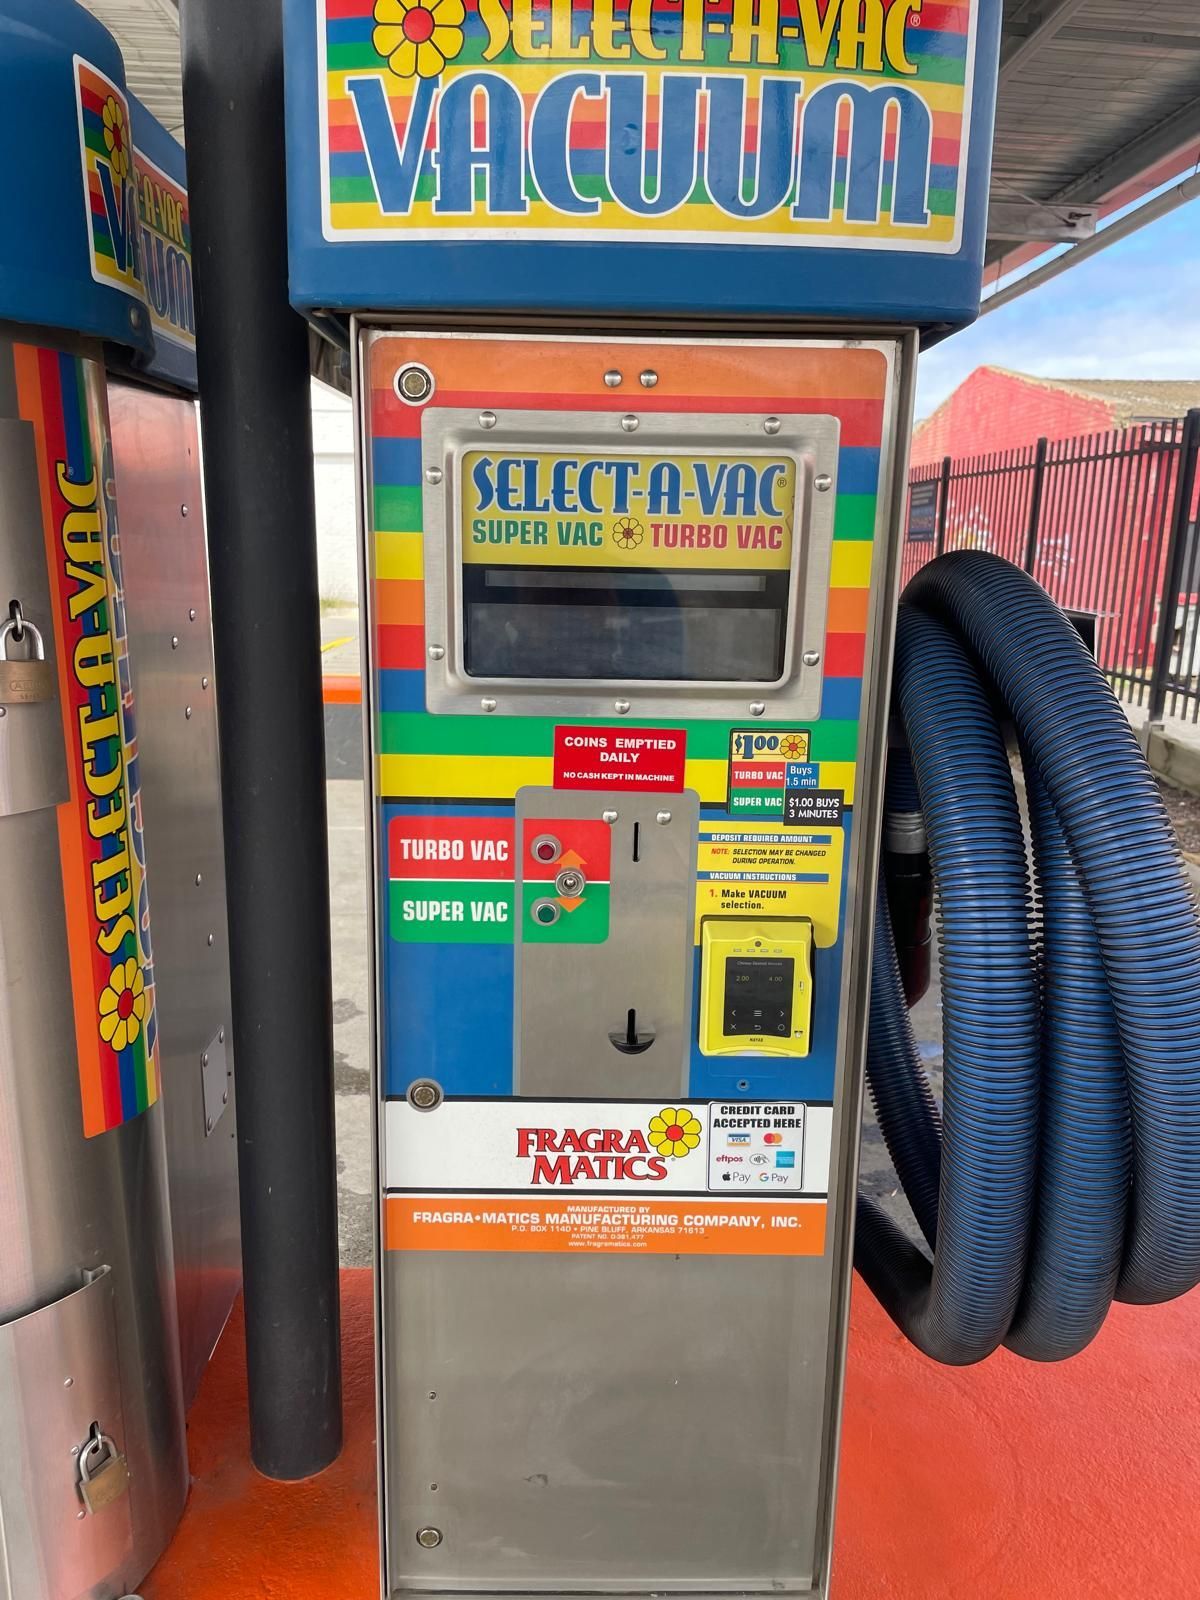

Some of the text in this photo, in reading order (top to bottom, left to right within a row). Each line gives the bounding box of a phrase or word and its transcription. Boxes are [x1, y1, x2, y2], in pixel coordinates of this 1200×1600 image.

[345, 71, 933, 225] VACUUM
[472, 519, 783, 550] SUPER VAC TURBO VAC
[564, 736, 676, 750] COINS EMPTIED
[600, 752, 640, 763] DAILY
[734, 771, 784, 780] TURBO VAC
[790, 765, 812, 776] Buys
[577, 772, 600, 780] CASH
[635, 774, 675, 782] MACHINE
[786, 778, 816, 786] 1.5 min
[733, 797, 782, 806] SUPER VAC
[789, 797, 840, 808] $1.00 BUYS
[789, 810, 838, 818] 3 MINUTES
[711, 834, 812, 843] DEPOSIT REQUIRED AMOUNT
[400, 839, 508, 861] TURBO VAC
[710, 872, 797, 881] VACUUM INSTRUCTIONS
[709, 889, 787, 899] 1. Make VACUUM
[721, 900, 764, 909] selection.
[403, 900, 508, 922] SUPER VAC
[720, 1105, 795, 1115] CREDIT CARD
[713, 1118, 802, 1128] ACCEPTED HERE
[516, 1128, 651, 1157] FRAGRA
[716, 1155, 743, 1164] eftpos
[531, 1155, 668, 1185] MATICS
[733, 1172, 751, 1184] Pay
[771, 1173, 789, 1184] Pay
[546, 1213, 678, 1226] MANUFACTURING
[684, 1215, 765, 1229] COMPANY,
[771, 1216, 802, 1228] INC.
[550, 1225, 571, 1233] 1140
[631, 1226, 675, 1234] ARKANSAS
[568, 1240, 647, 1248] www.fragramatics.com
